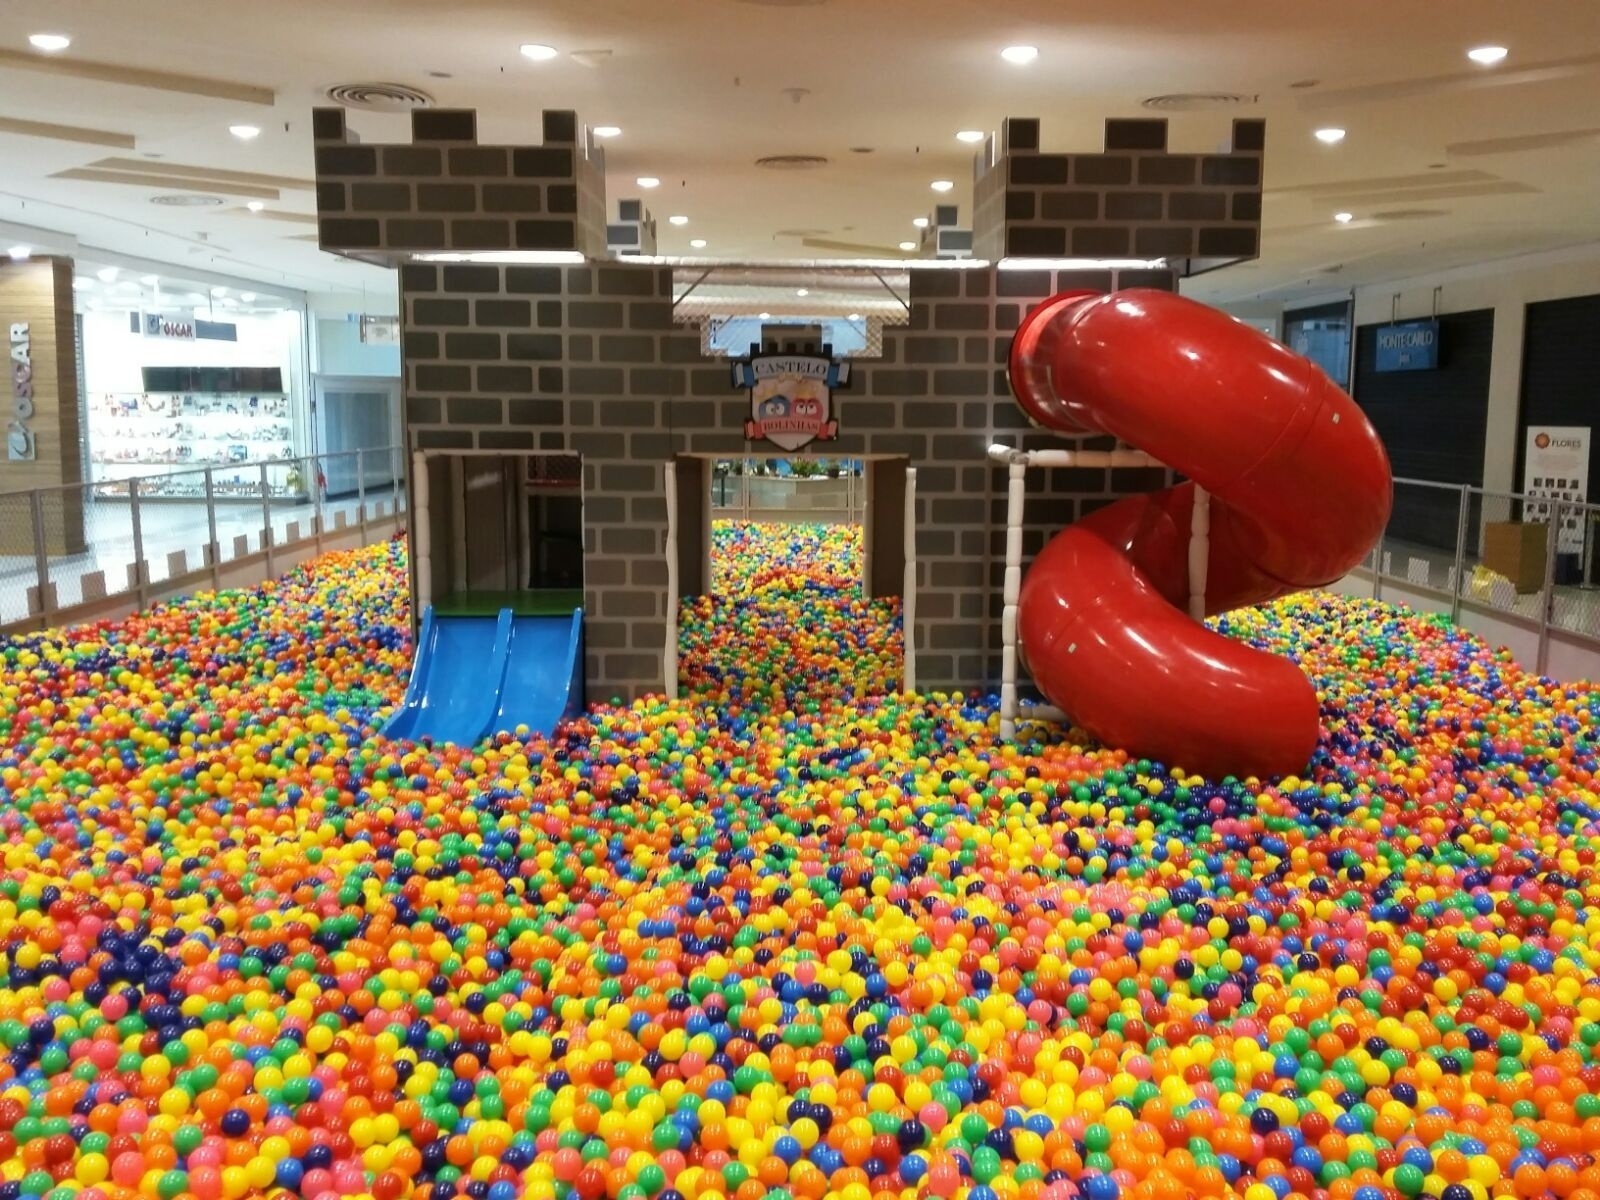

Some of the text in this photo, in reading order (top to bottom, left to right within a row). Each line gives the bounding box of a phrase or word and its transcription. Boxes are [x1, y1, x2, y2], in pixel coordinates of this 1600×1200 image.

[164, 322, 193, 338] OSCAR
[10, 322, 33, 419] OSCAR
[755, 360, 827, 374] CASTELO
[763, 420, 819, 432] BOLINHAS
[1551, 439, 1582, 448] FLORES
